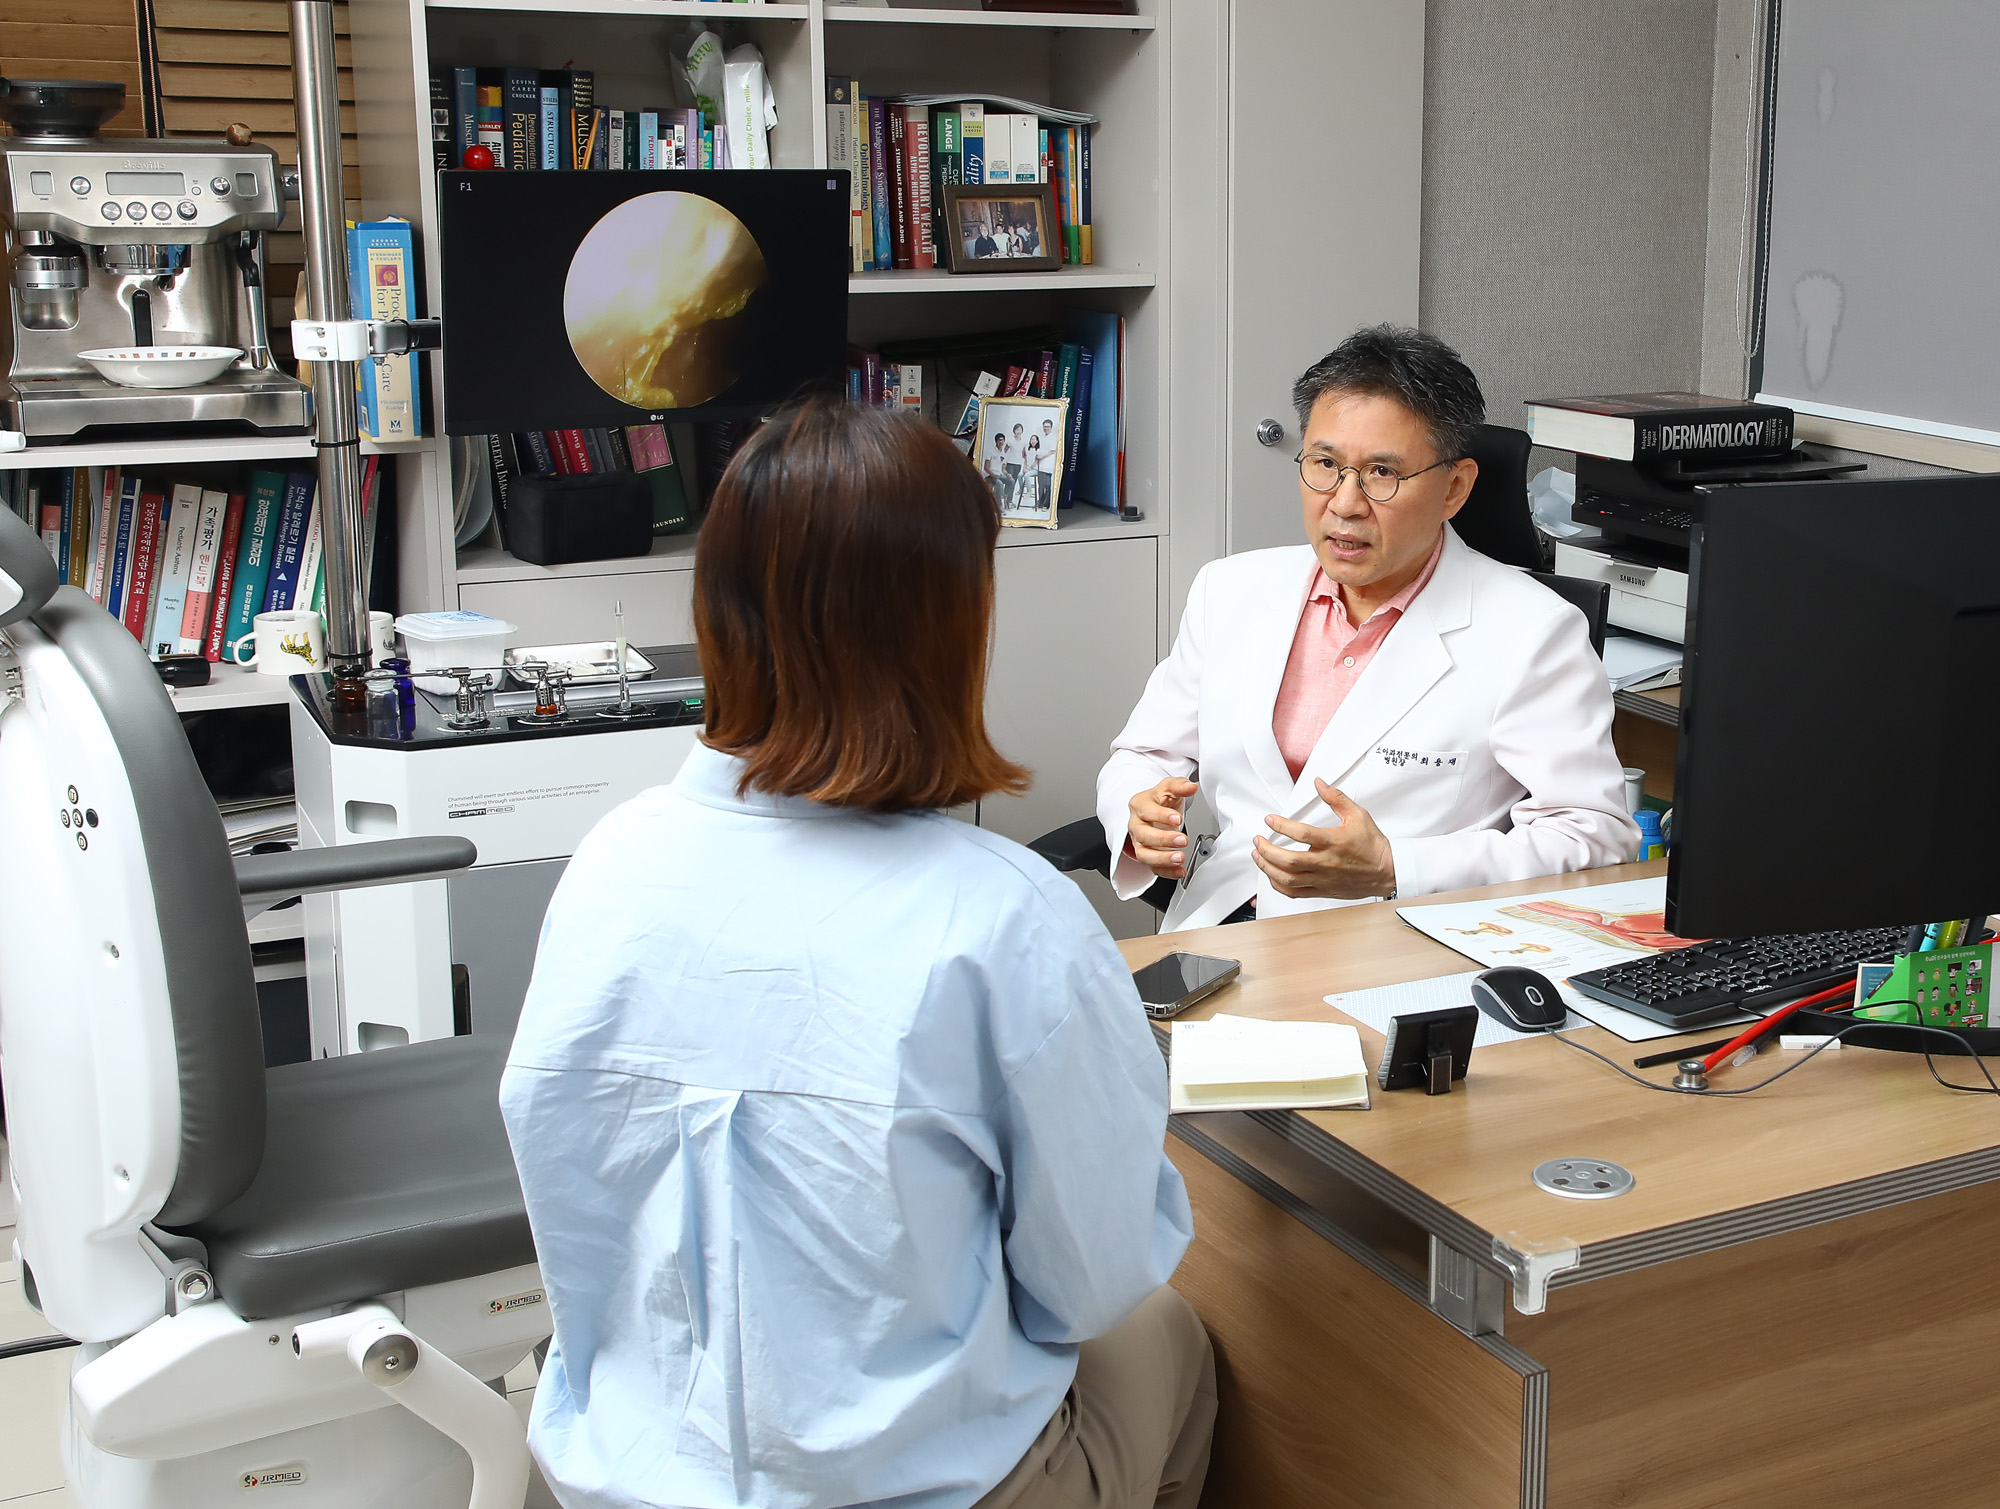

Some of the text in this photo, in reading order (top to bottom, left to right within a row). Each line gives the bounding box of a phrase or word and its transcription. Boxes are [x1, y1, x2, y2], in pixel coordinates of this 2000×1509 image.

[745, 105, 753, 132] Choice,
[547, 111, 555, 165] STRUCTURAL
[611, 135, 621, 164] Beyond
[746, 134, 755, 152] Daily
[874, 121, 883, 170] Malalignment
[123, 160, 167, 170] Breville
[861, 143, 871, 210] Ophthalmology
[460, 182, 472, 191] F1
[876, 171, 885, 208] Syndrome
[911, 181, 919, 198] HEIDI
[917, 123, 933, 254] REVOLUTIONARY WEALTH
[912, 200, 920, 225] TOFFLER
[376, 288, 389, 306] for
[381, 363, 392, 393] Care
[1040, 369, 1049, 398] PHYSICIAN
[572, 430, 581, 449] ung
[1069, 408, 1083, 472] ATOPIC DERMATITIS
[1661, 421, 1764, 451] DERMATOLOGY
[490, 433, 504, 470] KELETAL
[287, 485, 295, 507] Asthma
[118, 504, 131, 550] 비타민치료
[140, 502, 156, 554] 아동언어장애의
[248, 499, 270, 567] 항생제의 길잡이
[280, 520, 289, 544] Allergic
[284, 486, 307, 564] 천식과 알레르기 질환
[98, 544, 106, 567] THERAPY
[173, 526, 185, 575] Pediatric Asthma
[195, 506, 218, 587] 가족평가 핸드북
[275, 545, 285, 569] Diseases
[138, 554, 149, 571] 진단
[133, 581, 145, 595] 치료
[137, 571, 146, 580] 및
[1620, 574, 1646, 587] SAMSUNG
[95, 580, 103, 597] SPORT
[164, 596, 180, 604] Murphy
[215, 596, 227, 629] HAPPENING
[222, 580, 229, 588] MY
[241, 584, 254, 624] 대한감염학회
[1376, 746, 1418, 761] 소아과전문의
[1384, 756, 1406, 767] 병원장
[447, 794, 474, 803] Chammed
[506, 789, 525, 797] endless
[525, 787, 539, 795] effort
[545, 786, 562, 794] pursue
[584, 781, 609, 790] prosperity
[472, 799, 487, 807] being
[487, 797, 508, 805] through
[541, 792, 562, 800] activities
[575, 788, 601, 797] enterprise.
